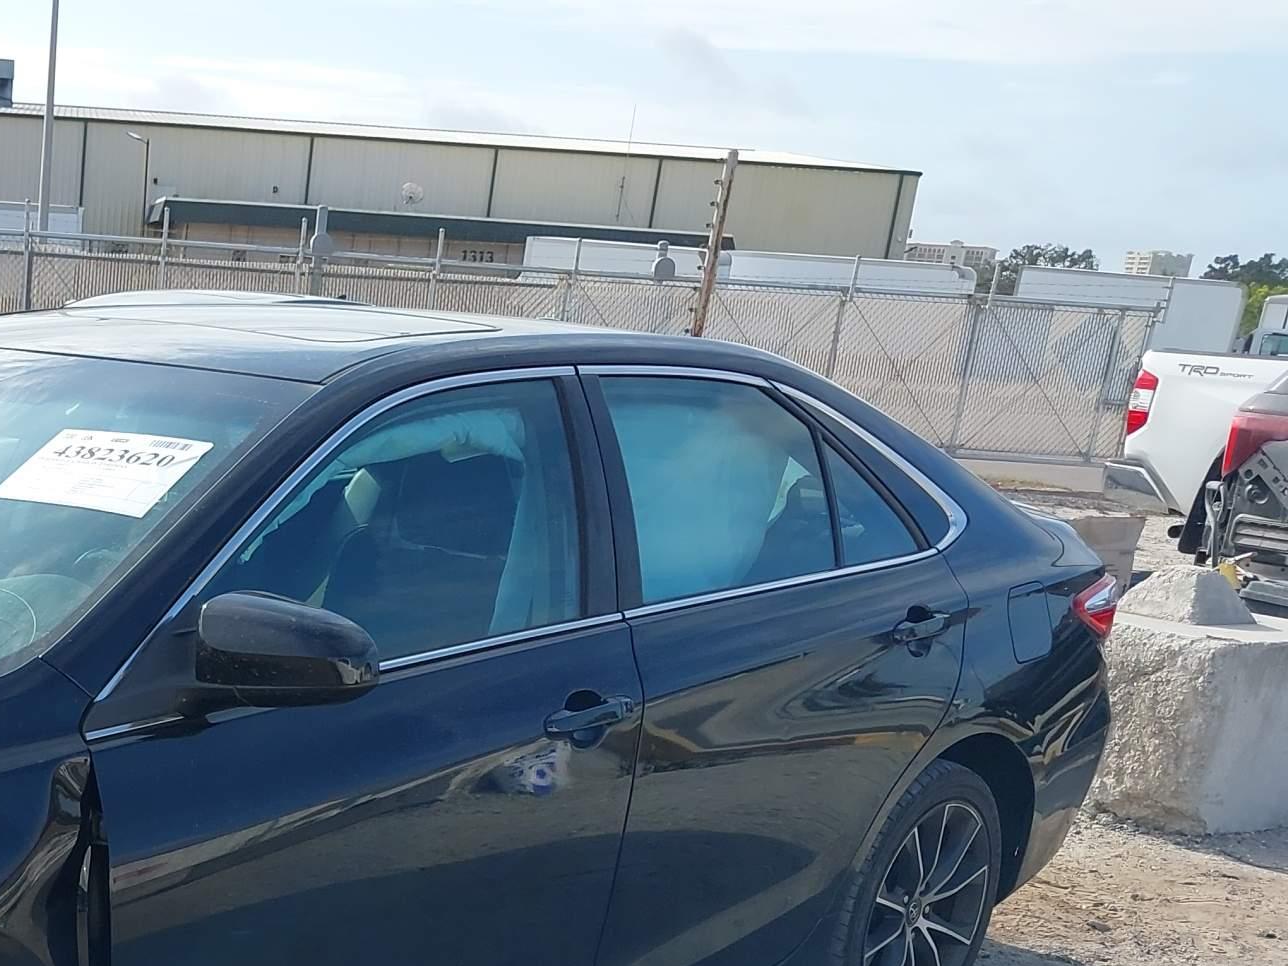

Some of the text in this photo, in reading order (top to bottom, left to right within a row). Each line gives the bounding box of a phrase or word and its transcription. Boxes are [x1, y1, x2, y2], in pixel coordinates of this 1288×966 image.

[461, 249, 494, 262] 1313
[1178, 363, 1255, 379] TRD SPORT
[53, 444, 176, 468] 43823620
